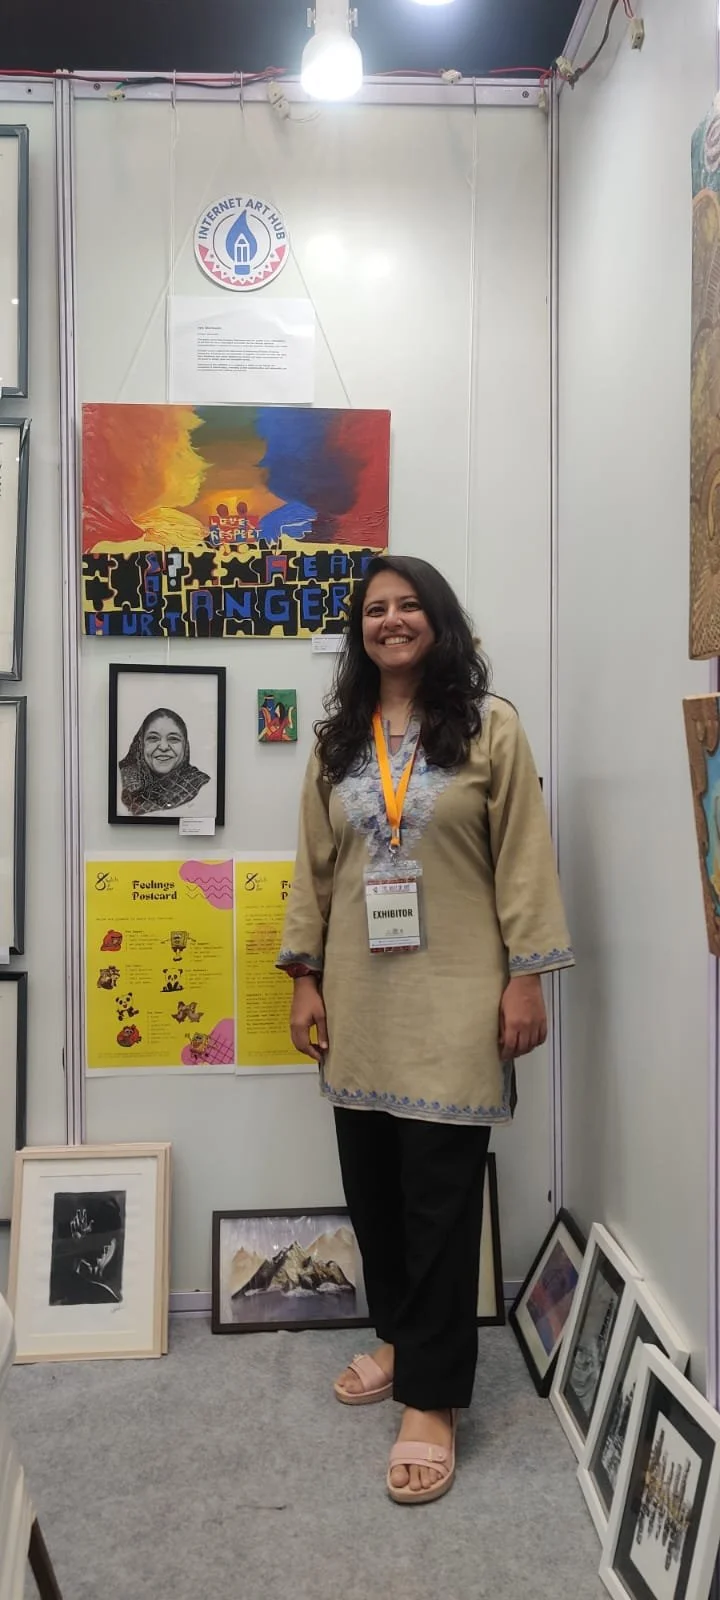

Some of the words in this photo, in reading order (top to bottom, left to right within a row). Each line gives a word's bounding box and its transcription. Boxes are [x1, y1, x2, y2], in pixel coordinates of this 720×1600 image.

[198, 197, 242, 240] INTERNET
[245, 198, 270, 216] ART
[267, 213, 286, 240] HUB
[190, 586, 351, 622] ANGER
[89, 611, 180, 635] HURT
[132, 880, 175, 892] Feelings
[132, 891, 177, 901] Postcard
[373, 908, 413, 920] EXHIBITOR
